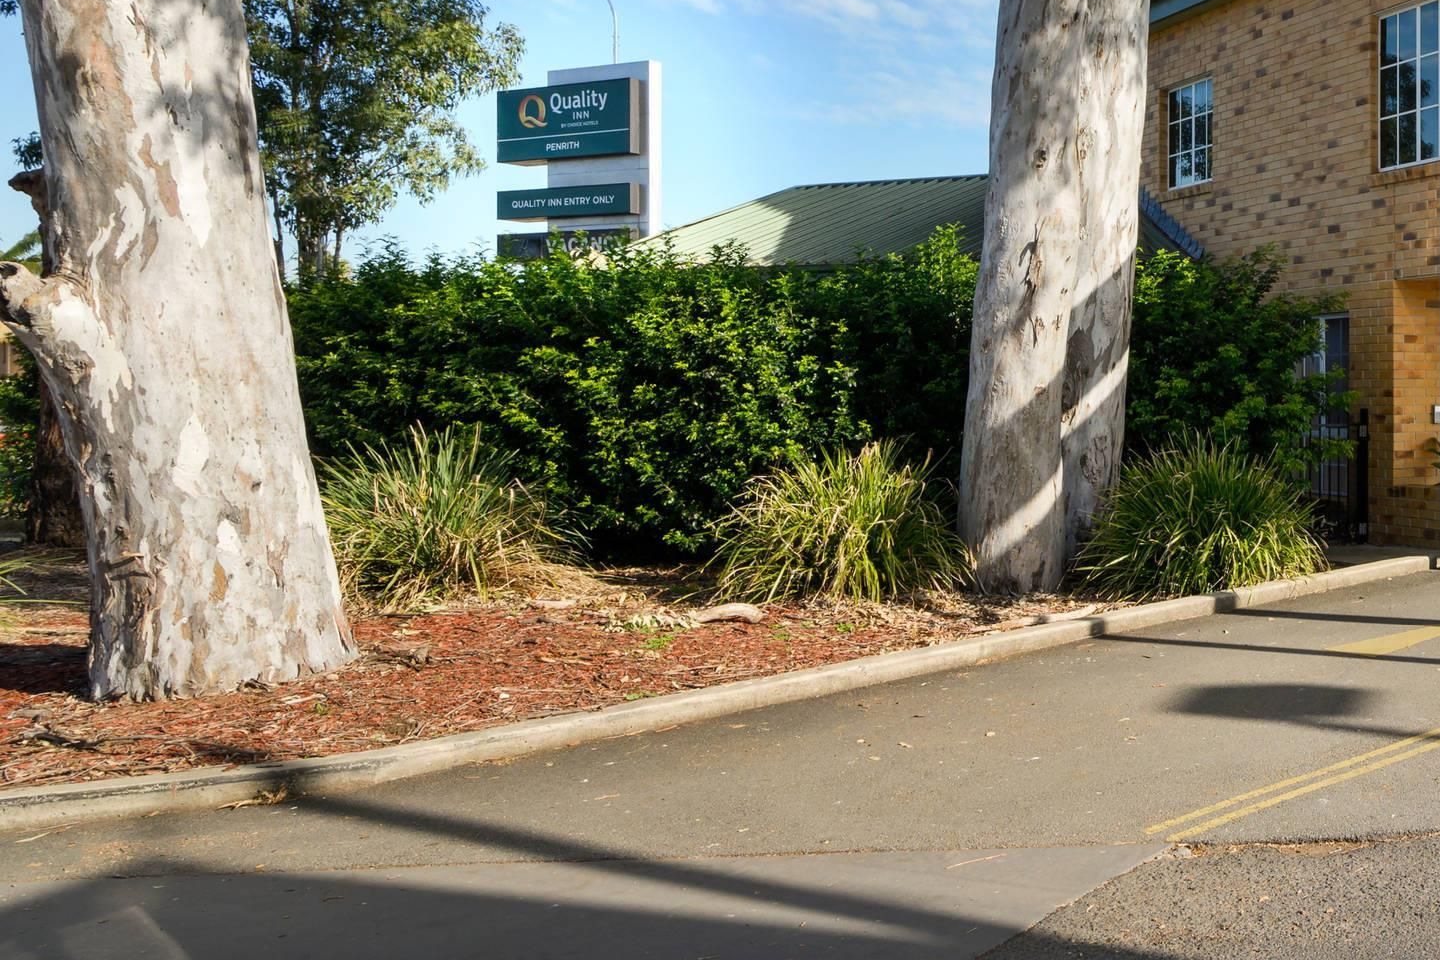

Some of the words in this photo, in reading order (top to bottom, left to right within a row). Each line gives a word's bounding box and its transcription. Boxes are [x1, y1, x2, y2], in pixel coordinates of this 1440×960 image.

[550, 90, 608, 114] Quality
[518, 95, 548, 128] Q
[572, 110, 590, 120] INN
[545, 141, 580, 152] PENRITH
[511, 199, 546, 208] QUALITY
[547, 198, 562, 207] INN
[564, 196, 591, 206] ENTRY
[592, 195, 615, 204] ONLY
